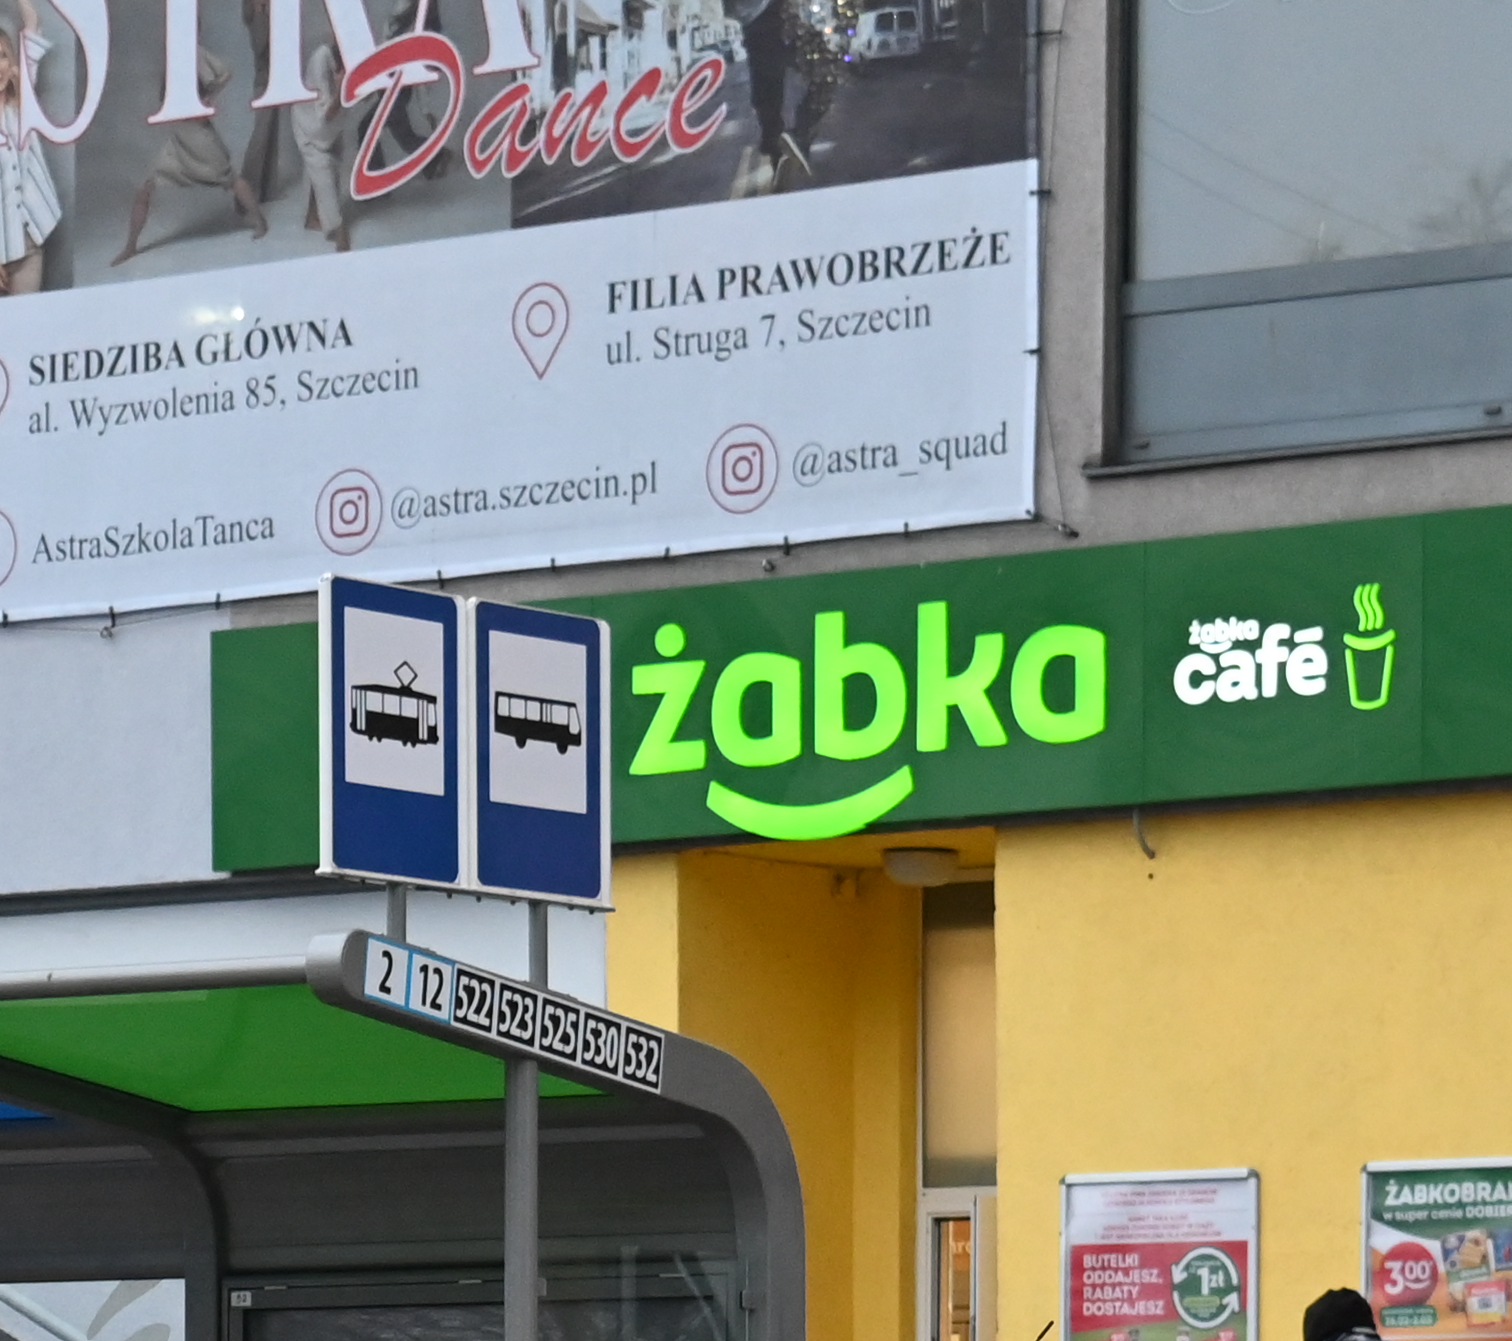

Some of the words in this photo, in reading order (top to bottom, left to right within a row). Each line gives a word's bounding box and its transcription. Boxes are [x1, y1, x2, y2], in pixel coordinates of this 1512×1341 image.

[342, 31, 729, 200] Dance
[606, 272, 707, 314] FILIA
[716, 227, 1013, 301] PRAWOBRZEŻE
[28, 340, 187, 387] SIEDZIBA
[195, 318, 354, 367] GŁÓWNA
[606, 332, 643, 365] ul.
[653, 322, 748, 366] Struga
[760, 314, 787, 351] 7,
[796, 296, 933, 345] Szczecin
[28, 402, 59, 435] al.
[69, 381, 236, 437] Wyzwolenia
[245, 375, 287, 412] 85,
[296, 358, 419, 404] Szczecin
[792, 422, 1010, 488] @astra_squad
[390, 461, 658, 530] @astra.szczecin.pl
[32, 514, 275, 566] AstraSzkolaTanca
[1173, 623, 1328, 705] café
[1188, 616, 1260, 645] żabka
[628, 601, 1107, 777] żabka
[378, 950, 394, 995] 2
[419, 964, 444, 1013] 12
[454, 974, 493, 1027] 522
[498, 989, 534, 1041] 523
[541, 1004, 577, 1054] 525
[582, 1018, 619, 1069] 530
[624, 1033, 659, 1084] 532
[1083, 1253, 1139, 1269] BUTELKI
[1083, 1285, 1139, 1301] RABATY
[1083, 1301, 1165, 1317] DOSTAJESZ
